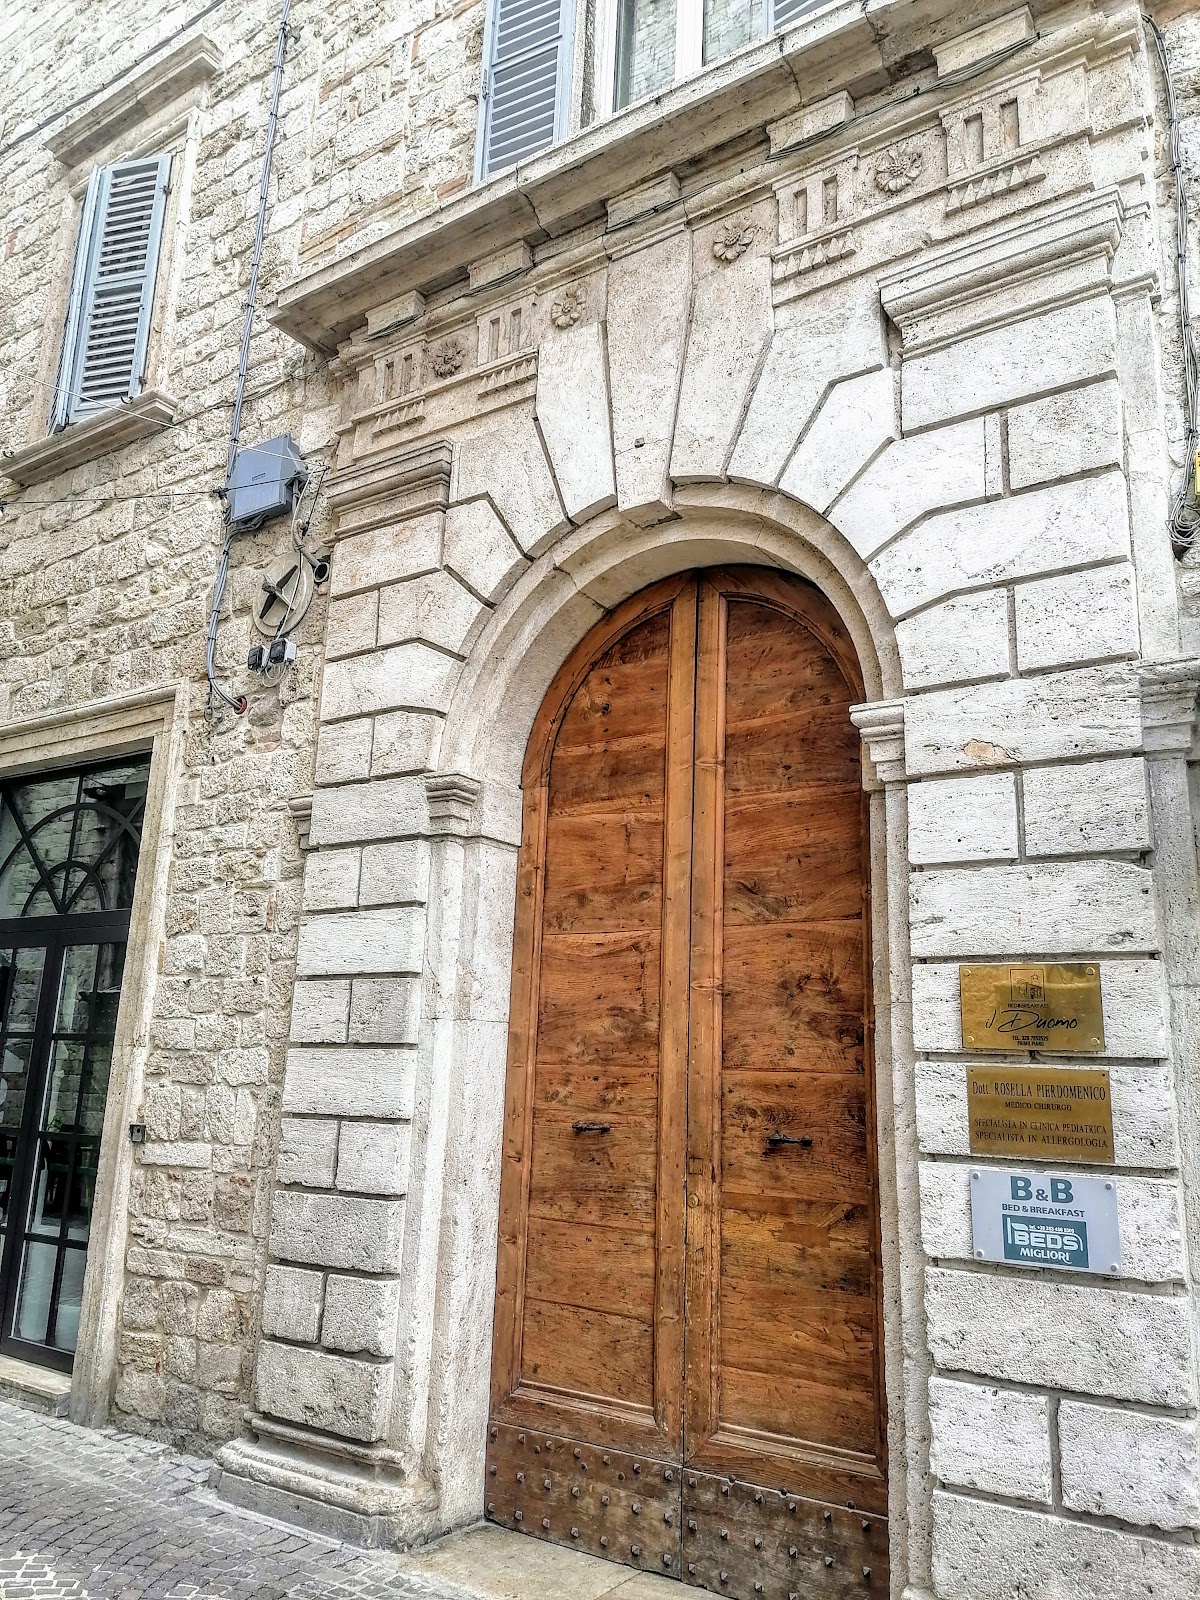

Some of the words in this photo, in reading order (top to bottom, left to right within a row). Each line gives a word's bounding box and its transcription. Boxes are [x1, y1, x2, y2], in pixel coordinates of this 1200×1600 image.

[985, 1009, 997, 1029] il
[997, 1009, 1078, 1033] Duomo
[972, 1081, 991, 1095] Dott.
[994, 1082, 1033, 1097] ROSELLA
[1036, 1084, 1106, 1101] PIERDOMENICO
[1004, 1101, 1032, 1109] MEDICO
[1034, 1102, 1072, 1111] CHIRURGO
[974, 1118, 1017, 1129] SPECIALISTA
[1019, 1120, 1028, 1130] IN
[1030, 1121, 1060, 1132] CLINICA
[1062, 1123, 1107, 1134] PEDIATRICA
[975, 1131, 1025, 1143] SPECIALISTA
[1028, 1134, 1037, 1143] IN
[1041, 1135, 1108, 1148] ALLERGOLOGIA
[1010, 1175, 1074, 1204] B&B
[1002, 1203, 1020, 1212] BED
[1029, 1206, 1085, 1218] BREAKFAST
[1013, 1231, 1079, 1251] BEDS
[1020, 1248, 1072, 1264] MIGLIORI
